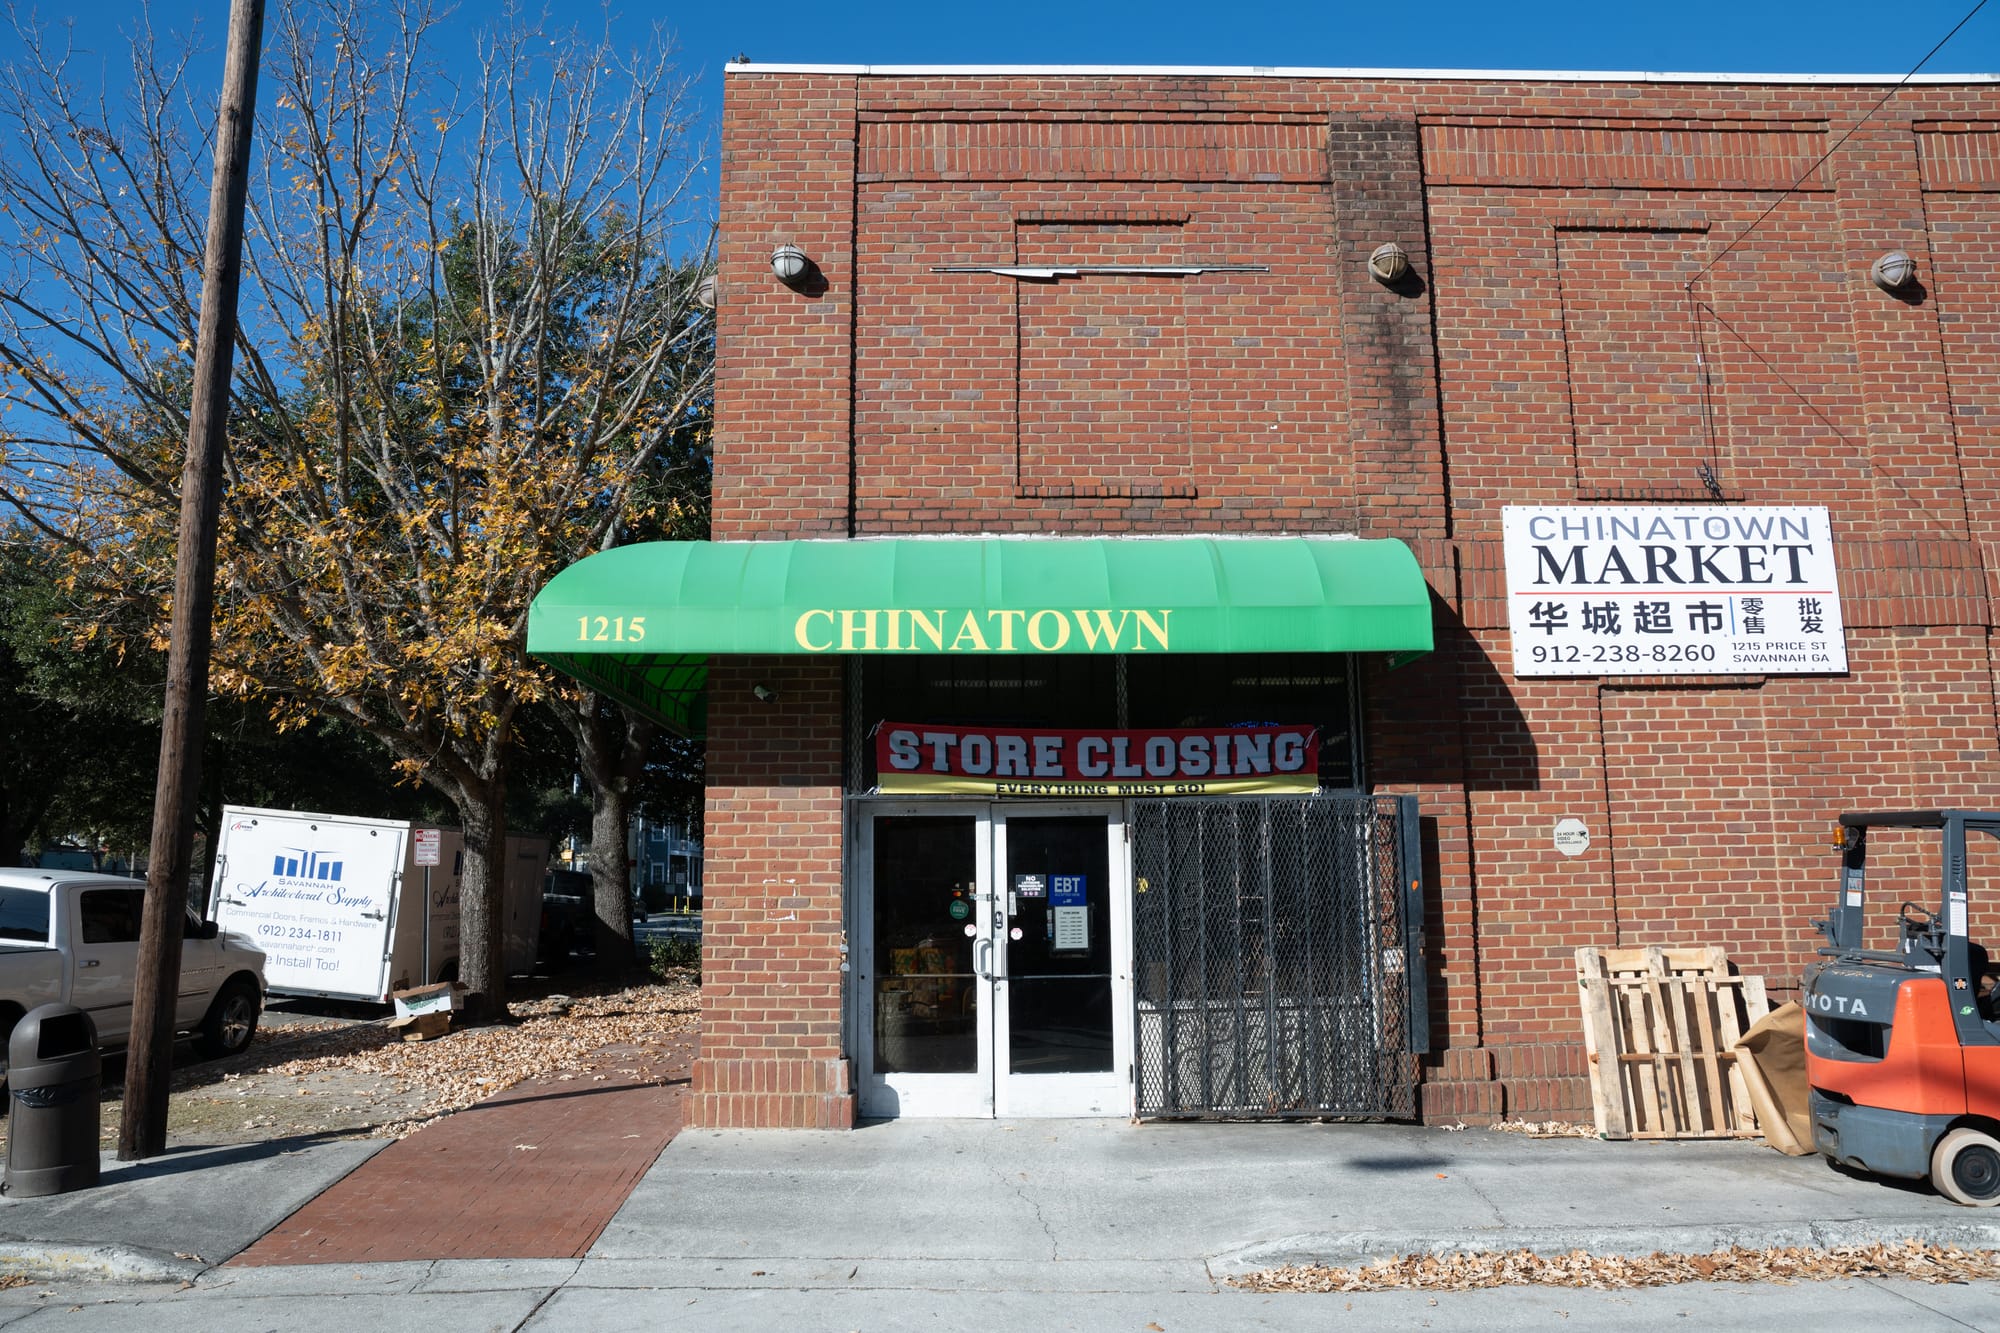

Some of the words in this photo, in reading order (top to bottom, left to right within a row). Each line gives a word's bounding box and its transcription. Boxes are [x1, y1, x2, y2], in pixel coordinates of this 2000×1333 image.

[1529, 516, 1809, 541] CHINATOWN
[1531, 544, 1813, 584] MARKET
[1529, 601, 1723, 635] 华城超市
[1741, 598, 1765, 634] 零售
[1798, 598, 1824, 634] 批发
[576, 616, 646, 642] 1215
[795, 609, 1172, 651] CHINATOWN
[1532, 645, 1715, 663] 912-238-8260
[1731, 642, 1760, 650] 1215
[1766, 642, 1806, 650] PRICE
[1811, 642, 1827, 650] ST
[1733, 654, 1806, 662] SAVANNAH
[1811, 654, 1829, 662] GA
[888, 730, 1064, 778] STORE
[1077, 731, 1306, 778] CLOSING
[995, 783, 1109, 795] EVERYTHING
[1118, 784, 1167, 795] MUST
[1175, 784, 1206, 794] GO!
[237, 881, 324, 901] Architectural
[326, 887, 373, 908] Supply
[279, 878, 334, 890] SAVANNAH
[1054, 877, 1081, 893] EBT
[226, 907, 272, 918] Commercial
[300, 914, 329, 925] Frames
[338, 918, 377, 929] Hardware
[257, 924, 287, 937] (912)
[289, 927, 342, 942] 234-1811
[276, 954, 312, 970] Install
[315, 957, 340, 972] Too!
[1805, 991, 1868, 1016] OYOTA
